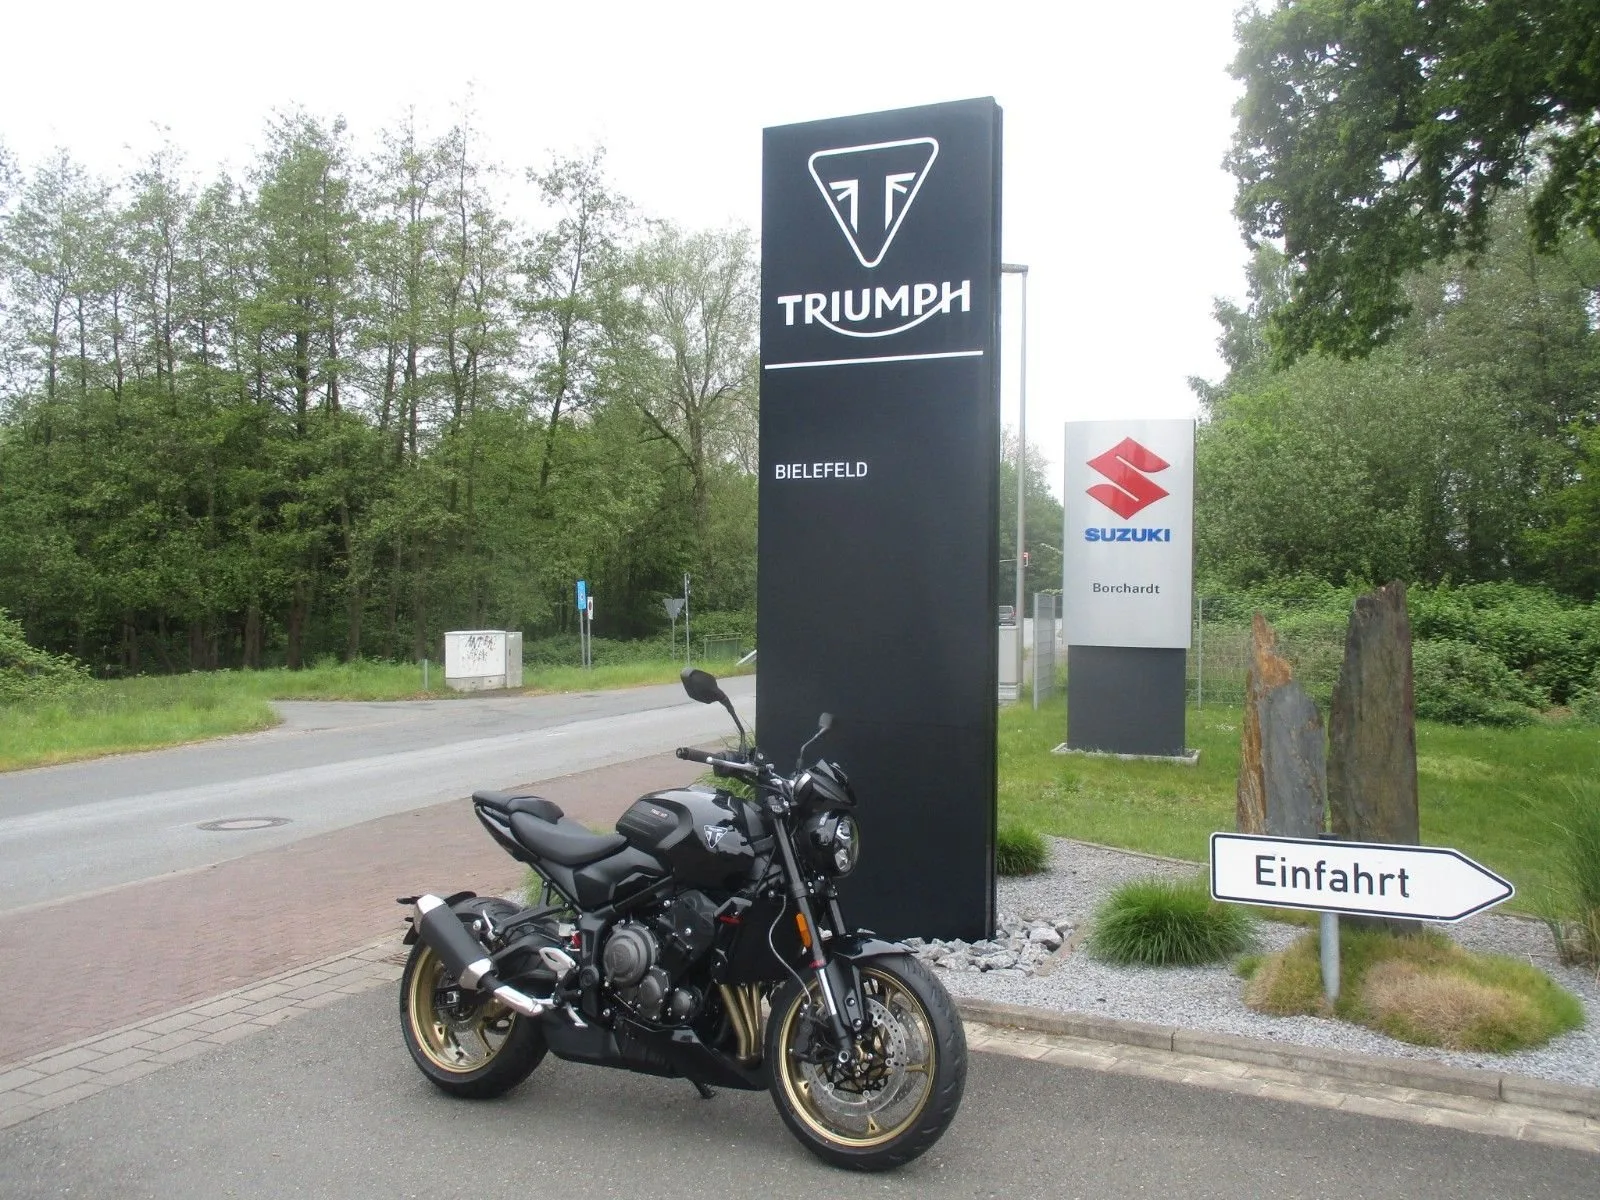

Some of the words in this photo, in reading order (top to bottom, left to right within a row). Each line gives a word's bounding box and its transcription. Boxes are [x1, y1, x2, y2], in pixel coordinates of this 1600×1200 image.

[777, 280, 971, 338] TRIUMPH
[774, 462, 868, 480] BIELEFELD
[1085, 528, 1171, 542] SUZUKI
[1093, 583, 1160, 594] Borchardt
[1255, 854, 1410, 898] Einfahrt
